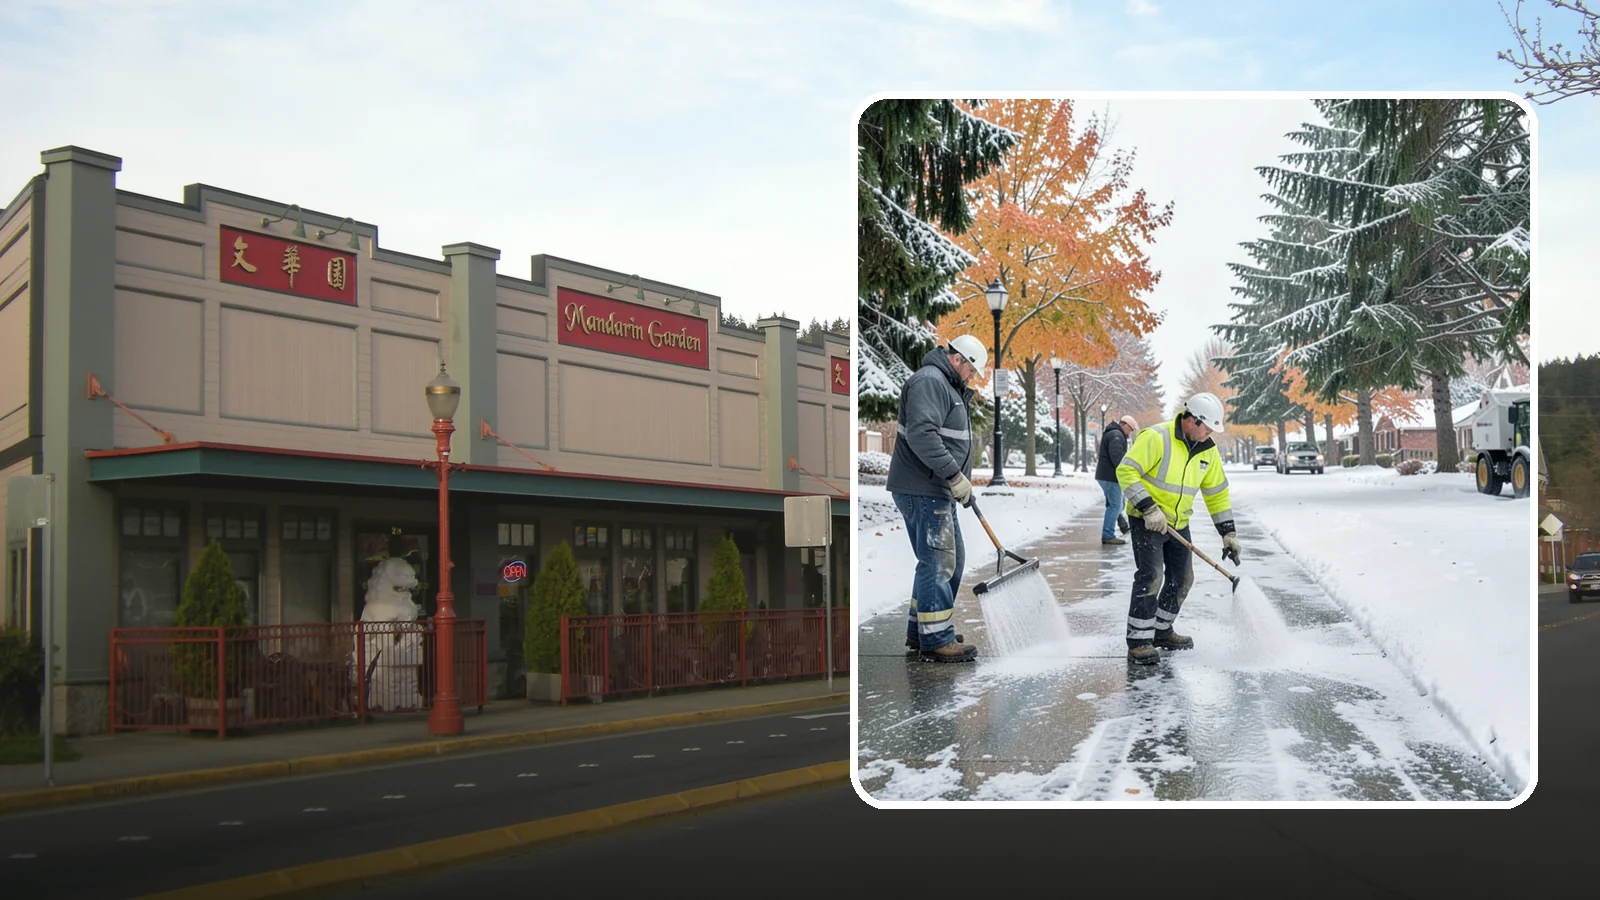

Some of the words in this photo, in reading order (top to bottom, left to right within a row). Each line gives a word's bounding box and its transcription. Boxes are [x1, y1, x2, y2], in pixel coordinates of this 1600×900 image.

[231, 235, 346, 291] 文華園
[564, 302, 644, 341] Mandarin
[648, 320, 701, 352] Garden
[503, 565, 527, 578] OPEN
